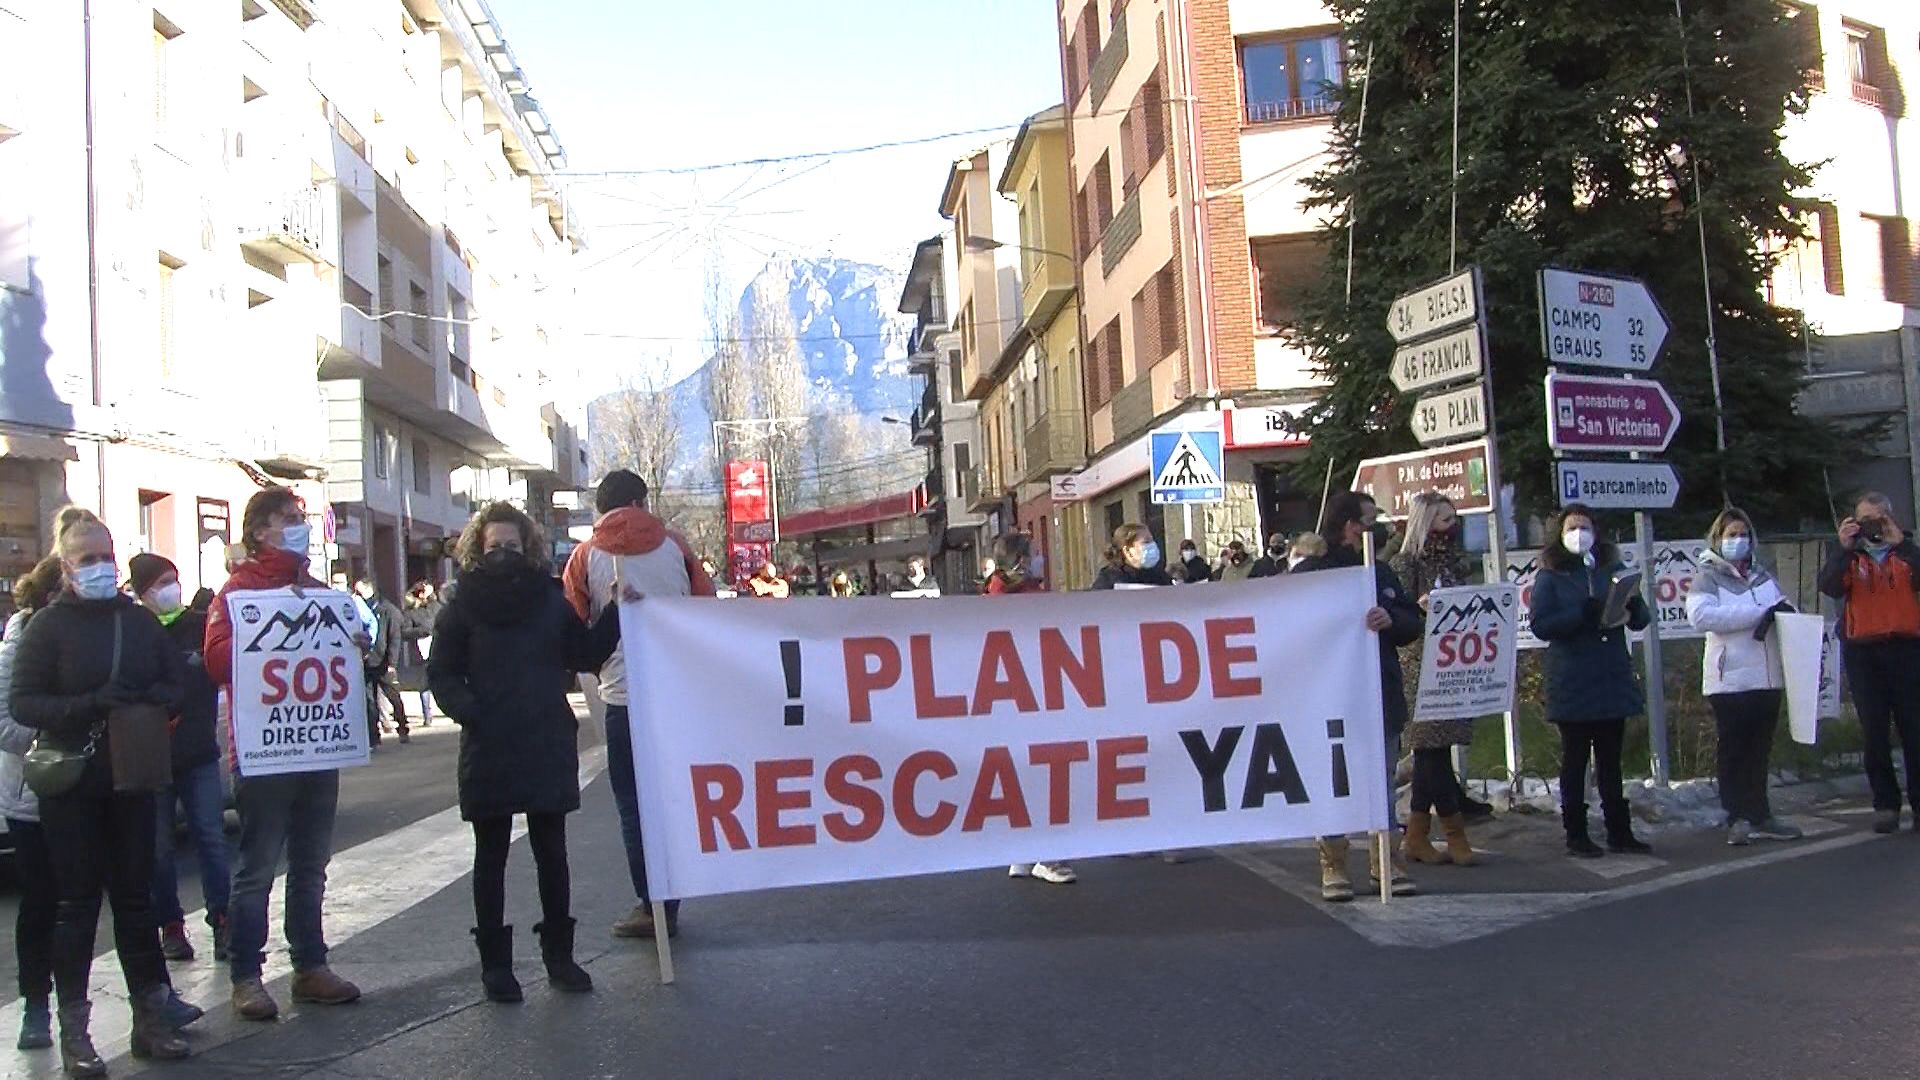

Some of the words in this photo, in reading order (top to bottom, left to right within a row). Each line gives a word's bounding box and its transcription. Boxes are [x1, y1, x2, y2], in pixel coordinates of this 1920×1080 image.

[1397, 304, 1413, 333] 34
[1427, 284, 1468, 322] BIELSA
[1551, 307, 1601, 332] CAMPO
[1627, 317, 1645, 336] 32
[1422, 338, 1473, 378] FRANCIA
[1553, 335, 1602, 358] GRAUS
[1630, 343, 1646, 363] 55
[1421, 405, 1437, 434] 39
[1447, 397, 1479, 428] PLAN
[1575, 394, 1630, 410] monasterio
[1634, 395, 1647, 410] de
[1577, 415, 1603, 436] San
[1606, 416, 1661, 438] Victorián
[1420, 464, 1432, 480] de
[1433, 460, 1464, 478] Ordesa
[1566, 472, 1577, 497] P
[1582, 477, 1668, 498] aparcamiento
[1436, 629, 1499, 669] SOS
[261, 656, 350, 706] SOS
[843, 624, 1107, 724] PLAN
[1138, 616, 1263, 704] DE
[268, 703, 346, 724] AYUDAS
[263, 723, 351, 747] DIRECTAS
[690, 735, 1150, 854] RESCATE
[1178, 722, 1311, 813] YA
